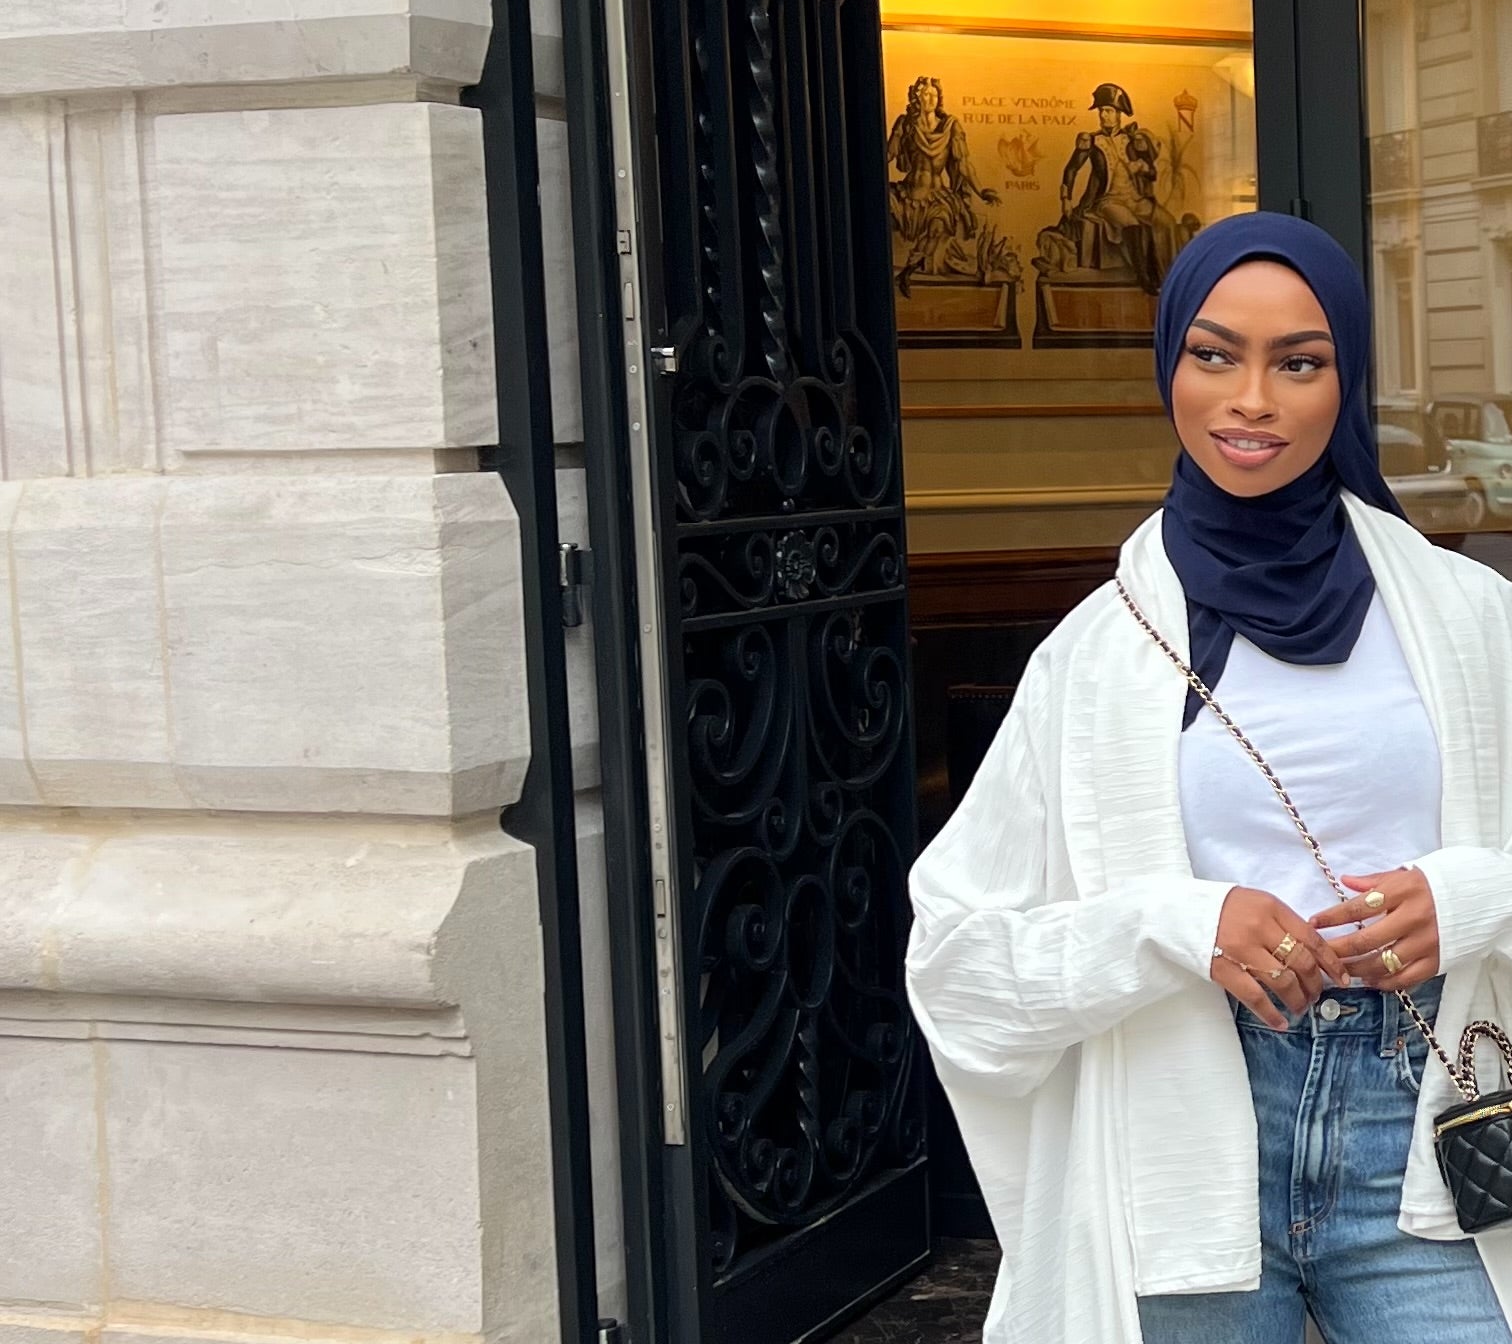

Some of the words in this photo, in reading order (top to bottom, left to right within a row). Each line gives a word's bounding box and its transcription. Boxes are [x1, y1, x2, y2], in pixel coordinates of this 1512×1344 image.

[962, 96, 1006, 107] PLACE
[1011, 96, 1077, 109] VENDÔME
[963, 113, 993, 124] RUE
[998, 114, 1014, 124] DE
[1018, 115, 1038, 125] LA
[1042, 115, 1077, 126] PAIX
[1005, 180, 1040, 191] PARIS
